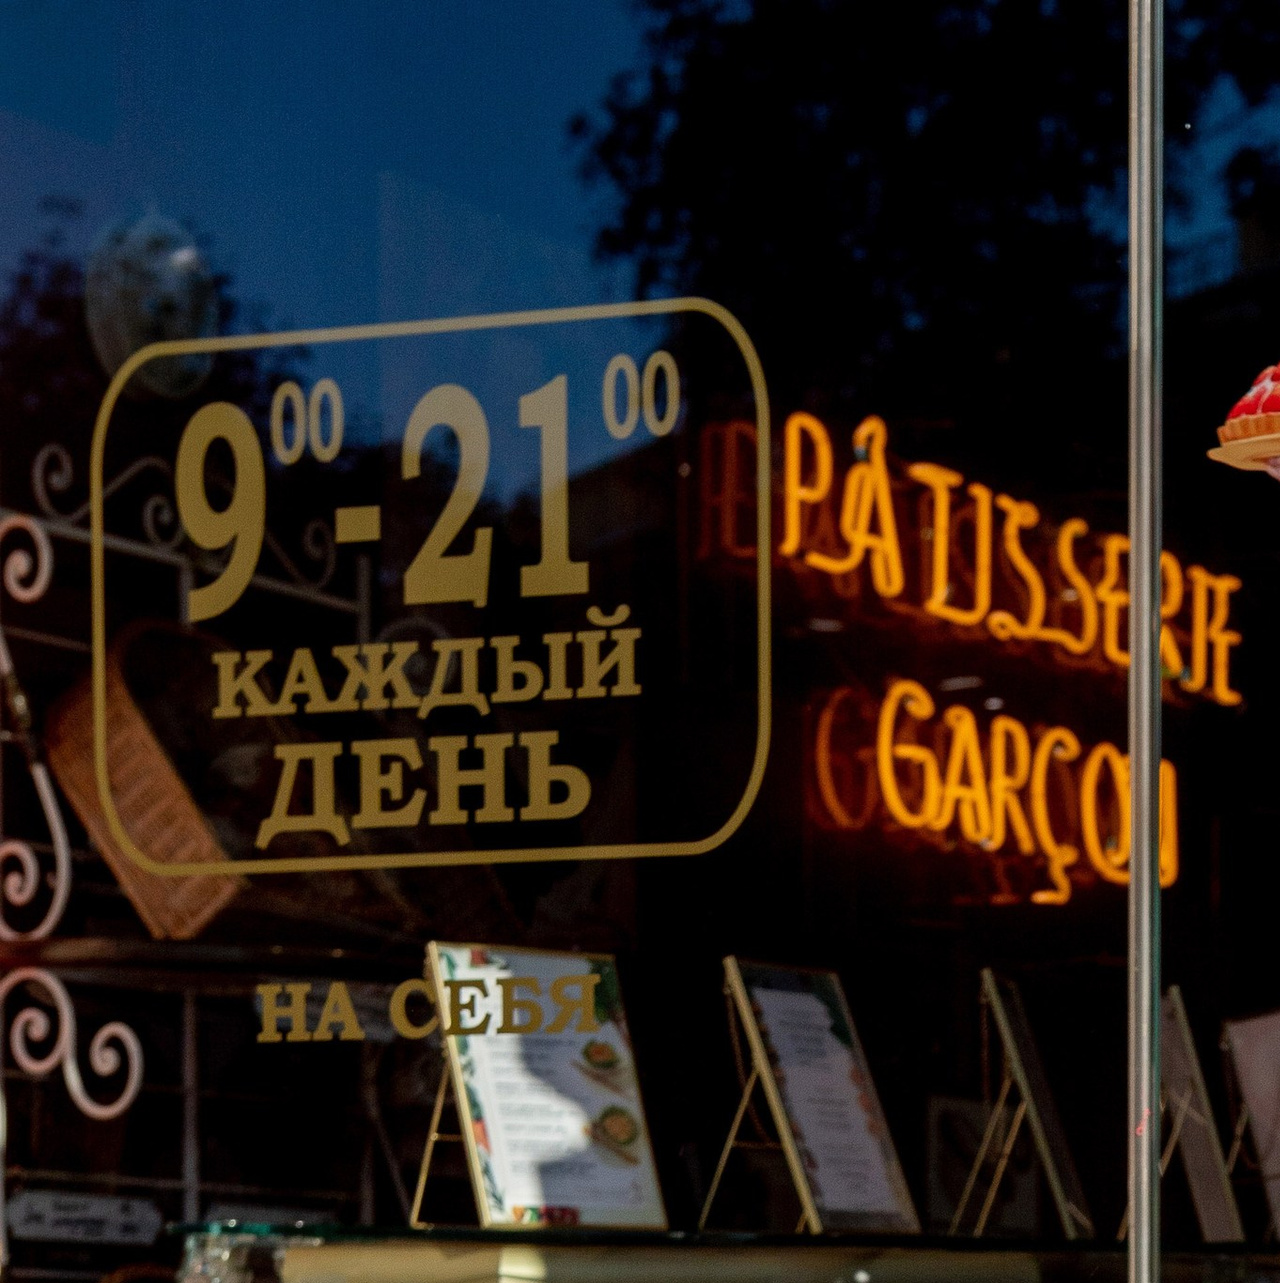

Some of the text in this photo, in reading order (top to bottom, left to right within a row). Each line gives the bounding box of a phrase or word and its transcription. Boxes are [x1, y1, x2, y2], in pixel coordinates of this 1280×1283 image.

[212, 603, 643, 720] КАЖДЫЙ
[255, 730, 592, 848] ДЕНЬ
[255, 973, 602, 1043] НА СЕБЯ
